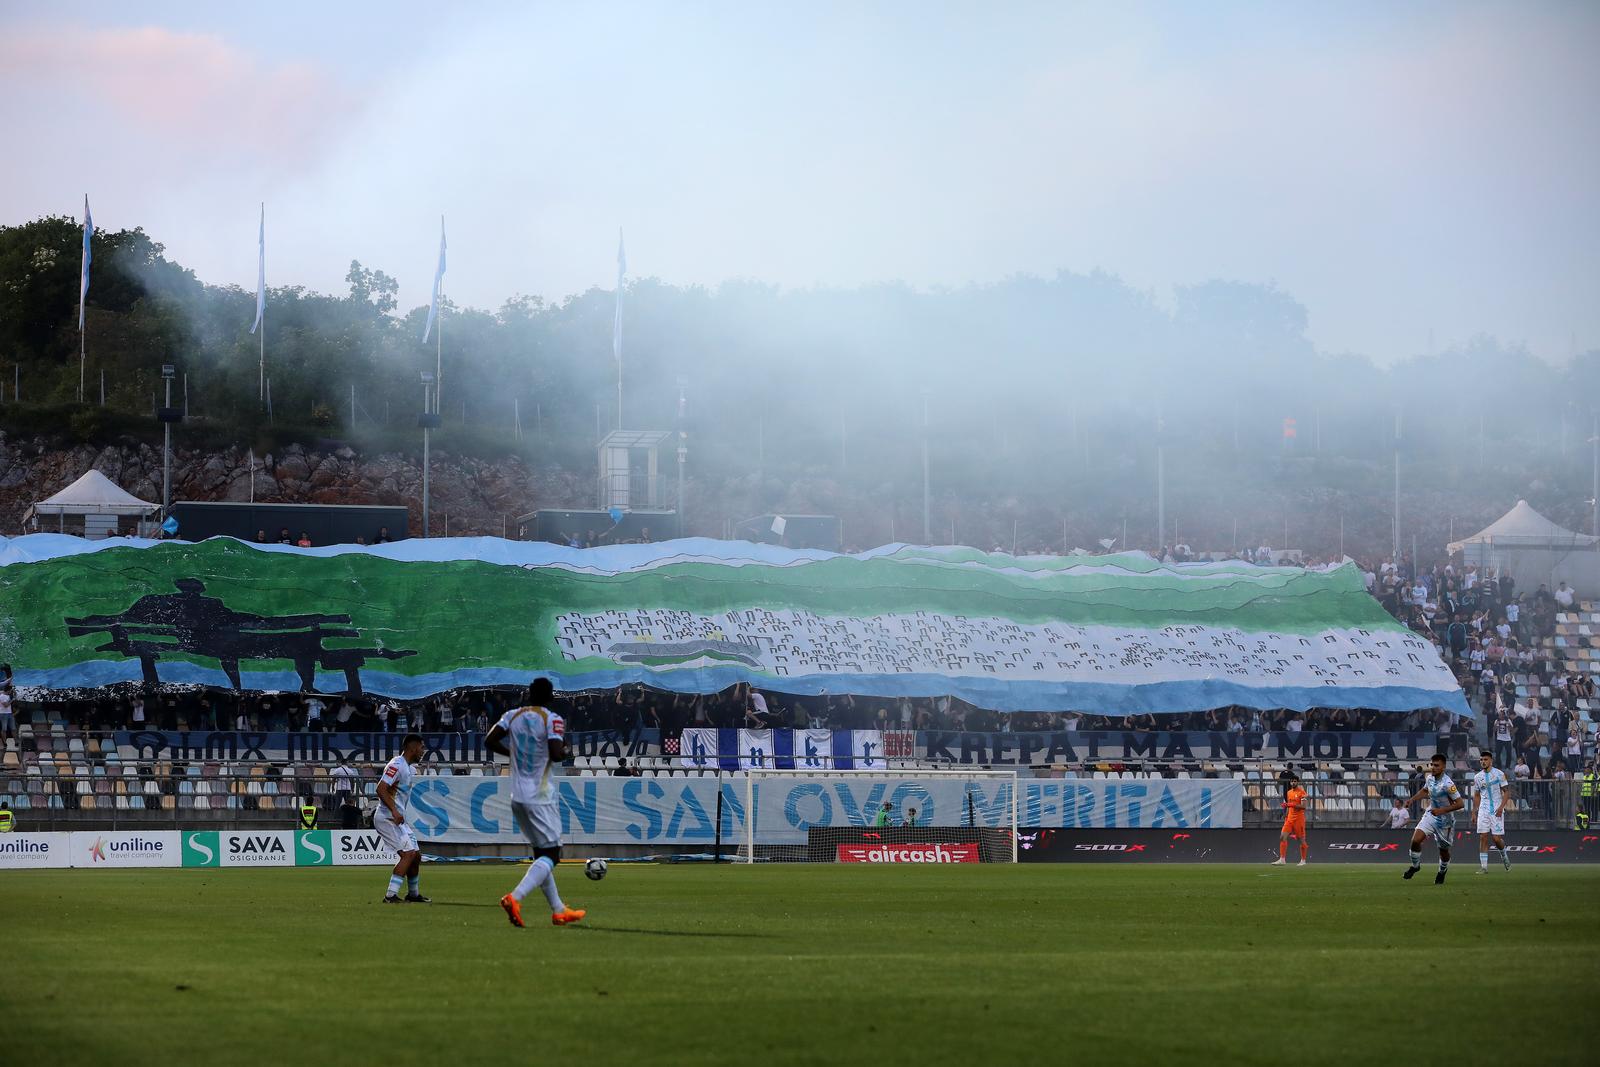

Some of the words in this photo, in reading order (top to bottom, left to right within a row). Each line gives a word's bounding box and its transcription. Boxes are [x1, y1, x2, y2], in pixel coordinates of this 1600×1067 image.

[926, 732, 1108, 764] KREPAT
[1122, 731, 1196, 761] MA
[470, 780, 597, 835] CN
[622, 779, 760, 840] SAN
[783, 782, 935, 832] OVO
[110, 838, 163, 851] uniline
[229, 836, 286, 853] SAVA
[340, 835, 384, 852] SAV
[341, 853, 398, 861] OSIGURANJE
[868, 845, 952, 863] aircash
